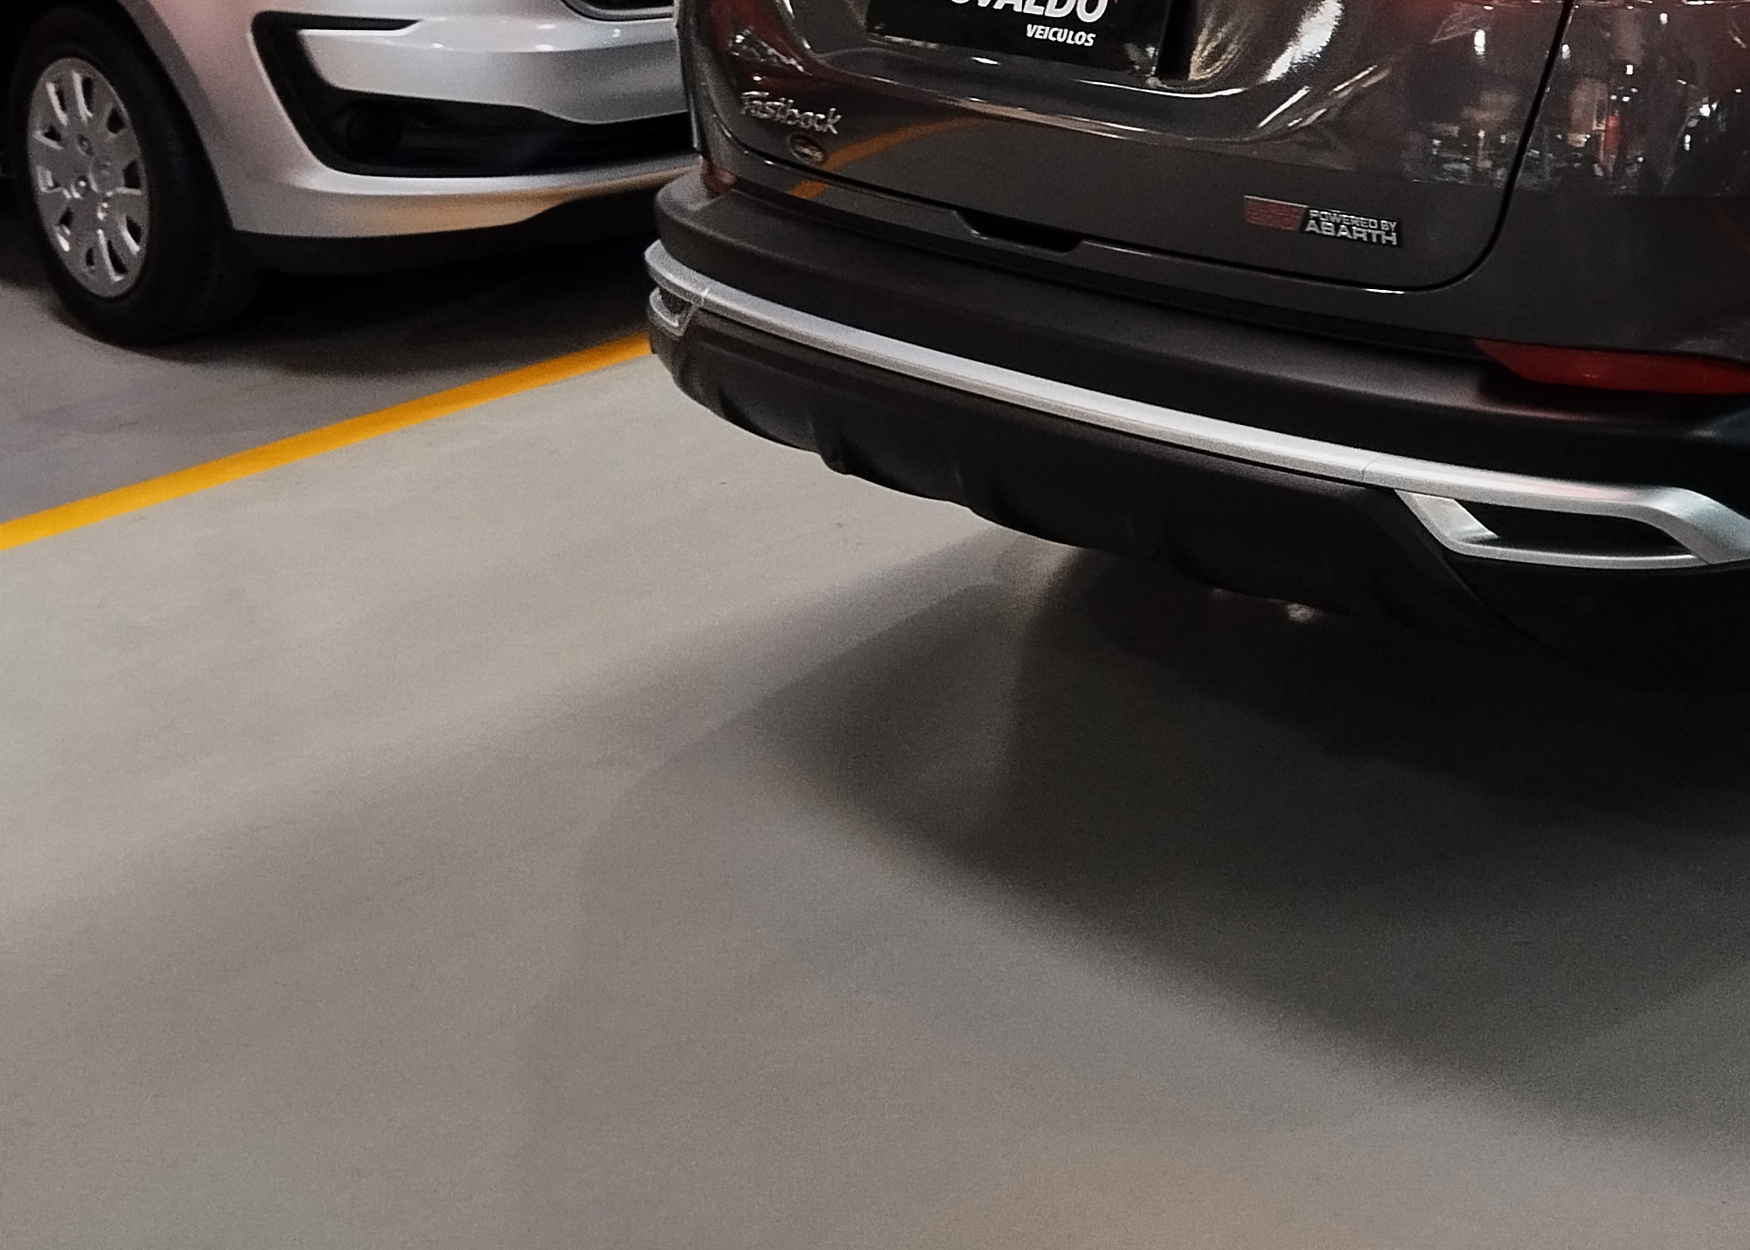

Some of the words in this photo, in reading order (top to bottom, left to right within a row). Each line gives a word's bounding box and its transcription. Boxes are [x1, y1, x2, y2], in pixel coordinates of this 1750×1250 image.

[1025, 23, 1097, 47] VEICULOS
[1304, 219, 1398, 246] ABARTH
[1309, 209, 1379, 230] POWERED
[1380, 219, 1397, 232] BY
